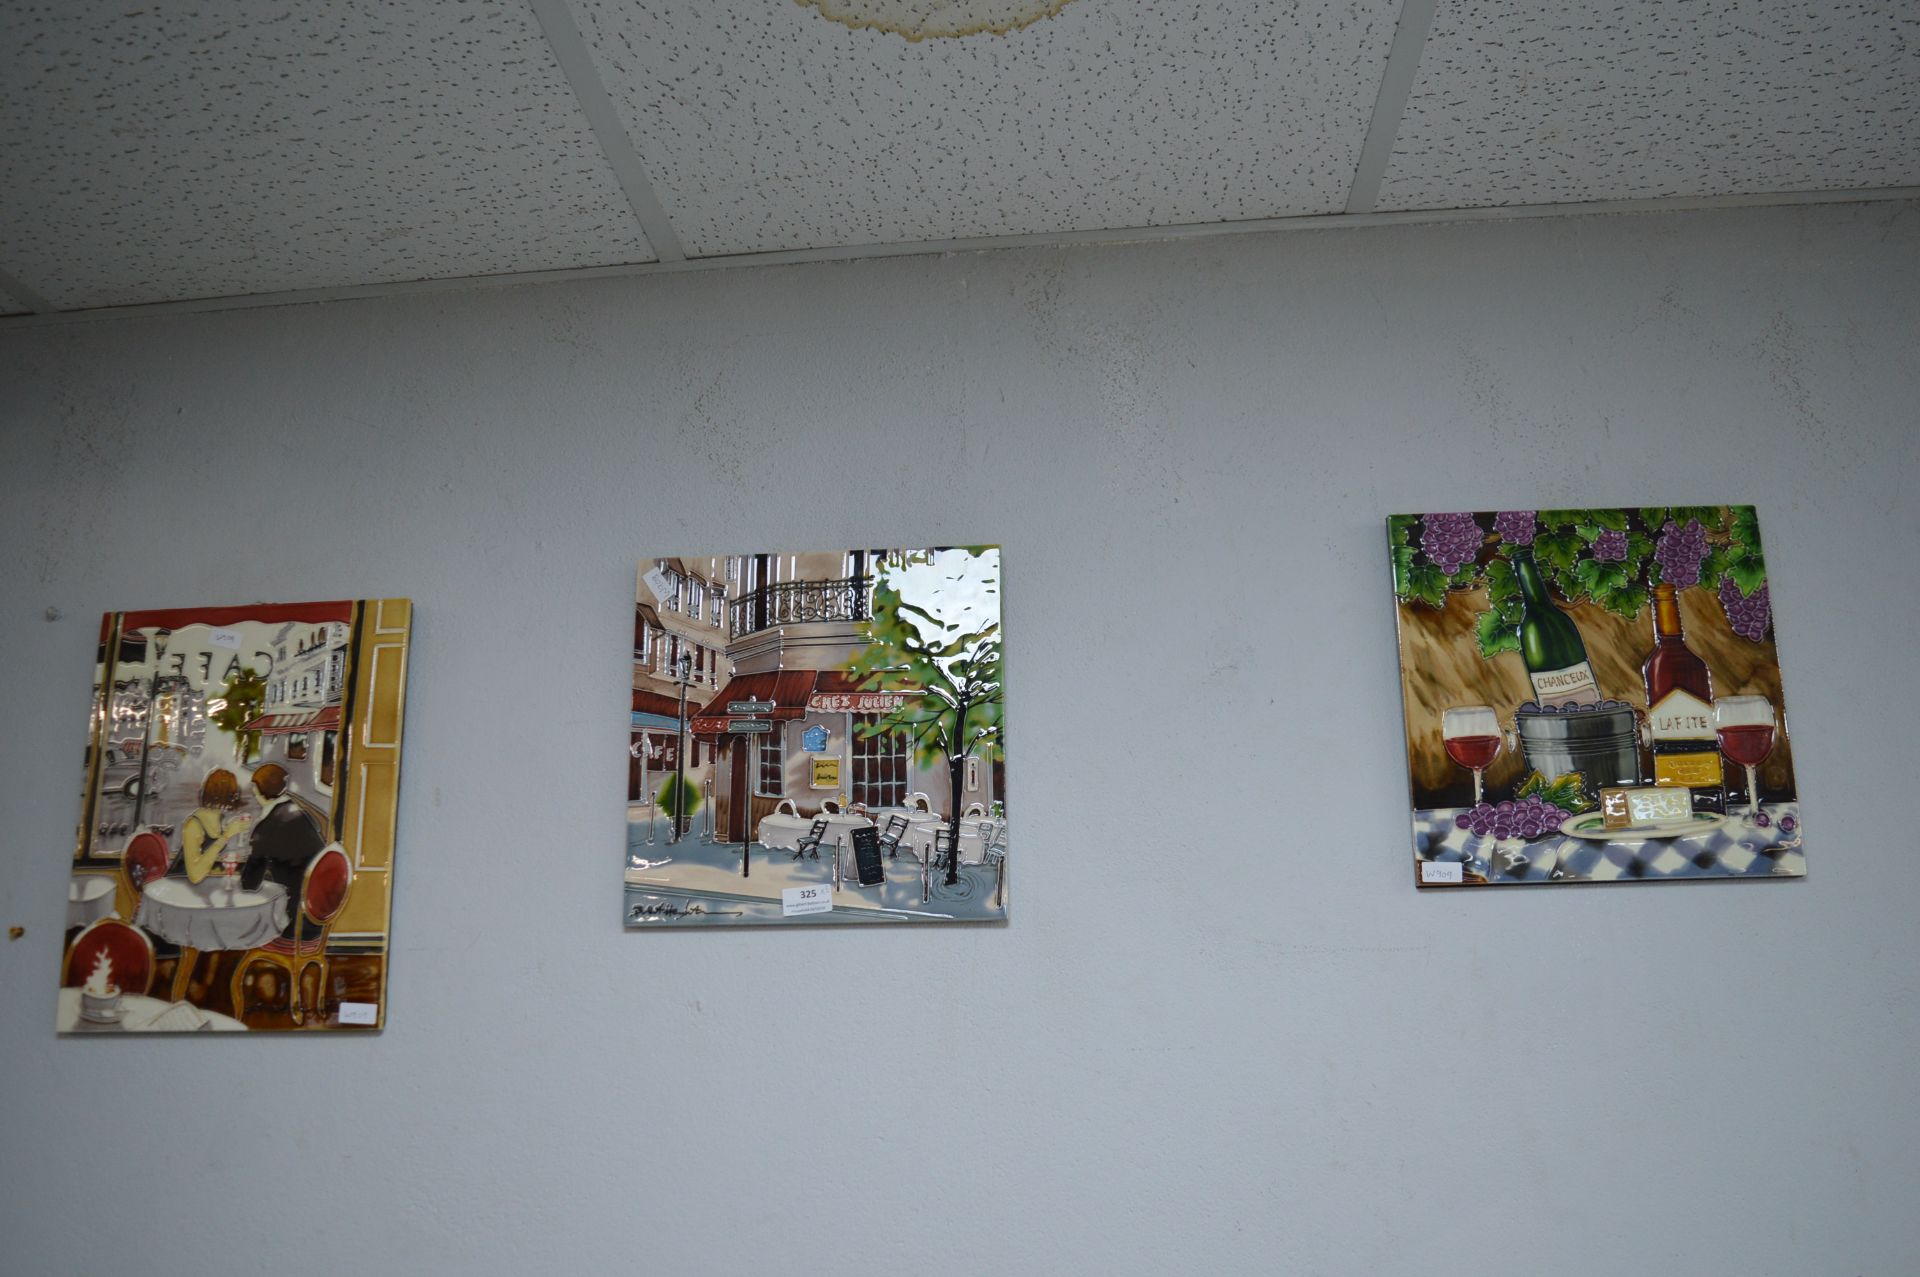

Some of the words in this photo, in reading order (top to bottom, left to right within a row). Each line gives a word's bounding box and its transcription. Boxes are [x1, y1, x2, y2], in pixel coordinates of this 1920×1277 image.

[1537, 669, 1590, 690] CHANCEUX
[811, 694, 851, 709] CHEZ
[857, 694, 904, 709] JULIEN
[799, 889, 817, 899] 325
